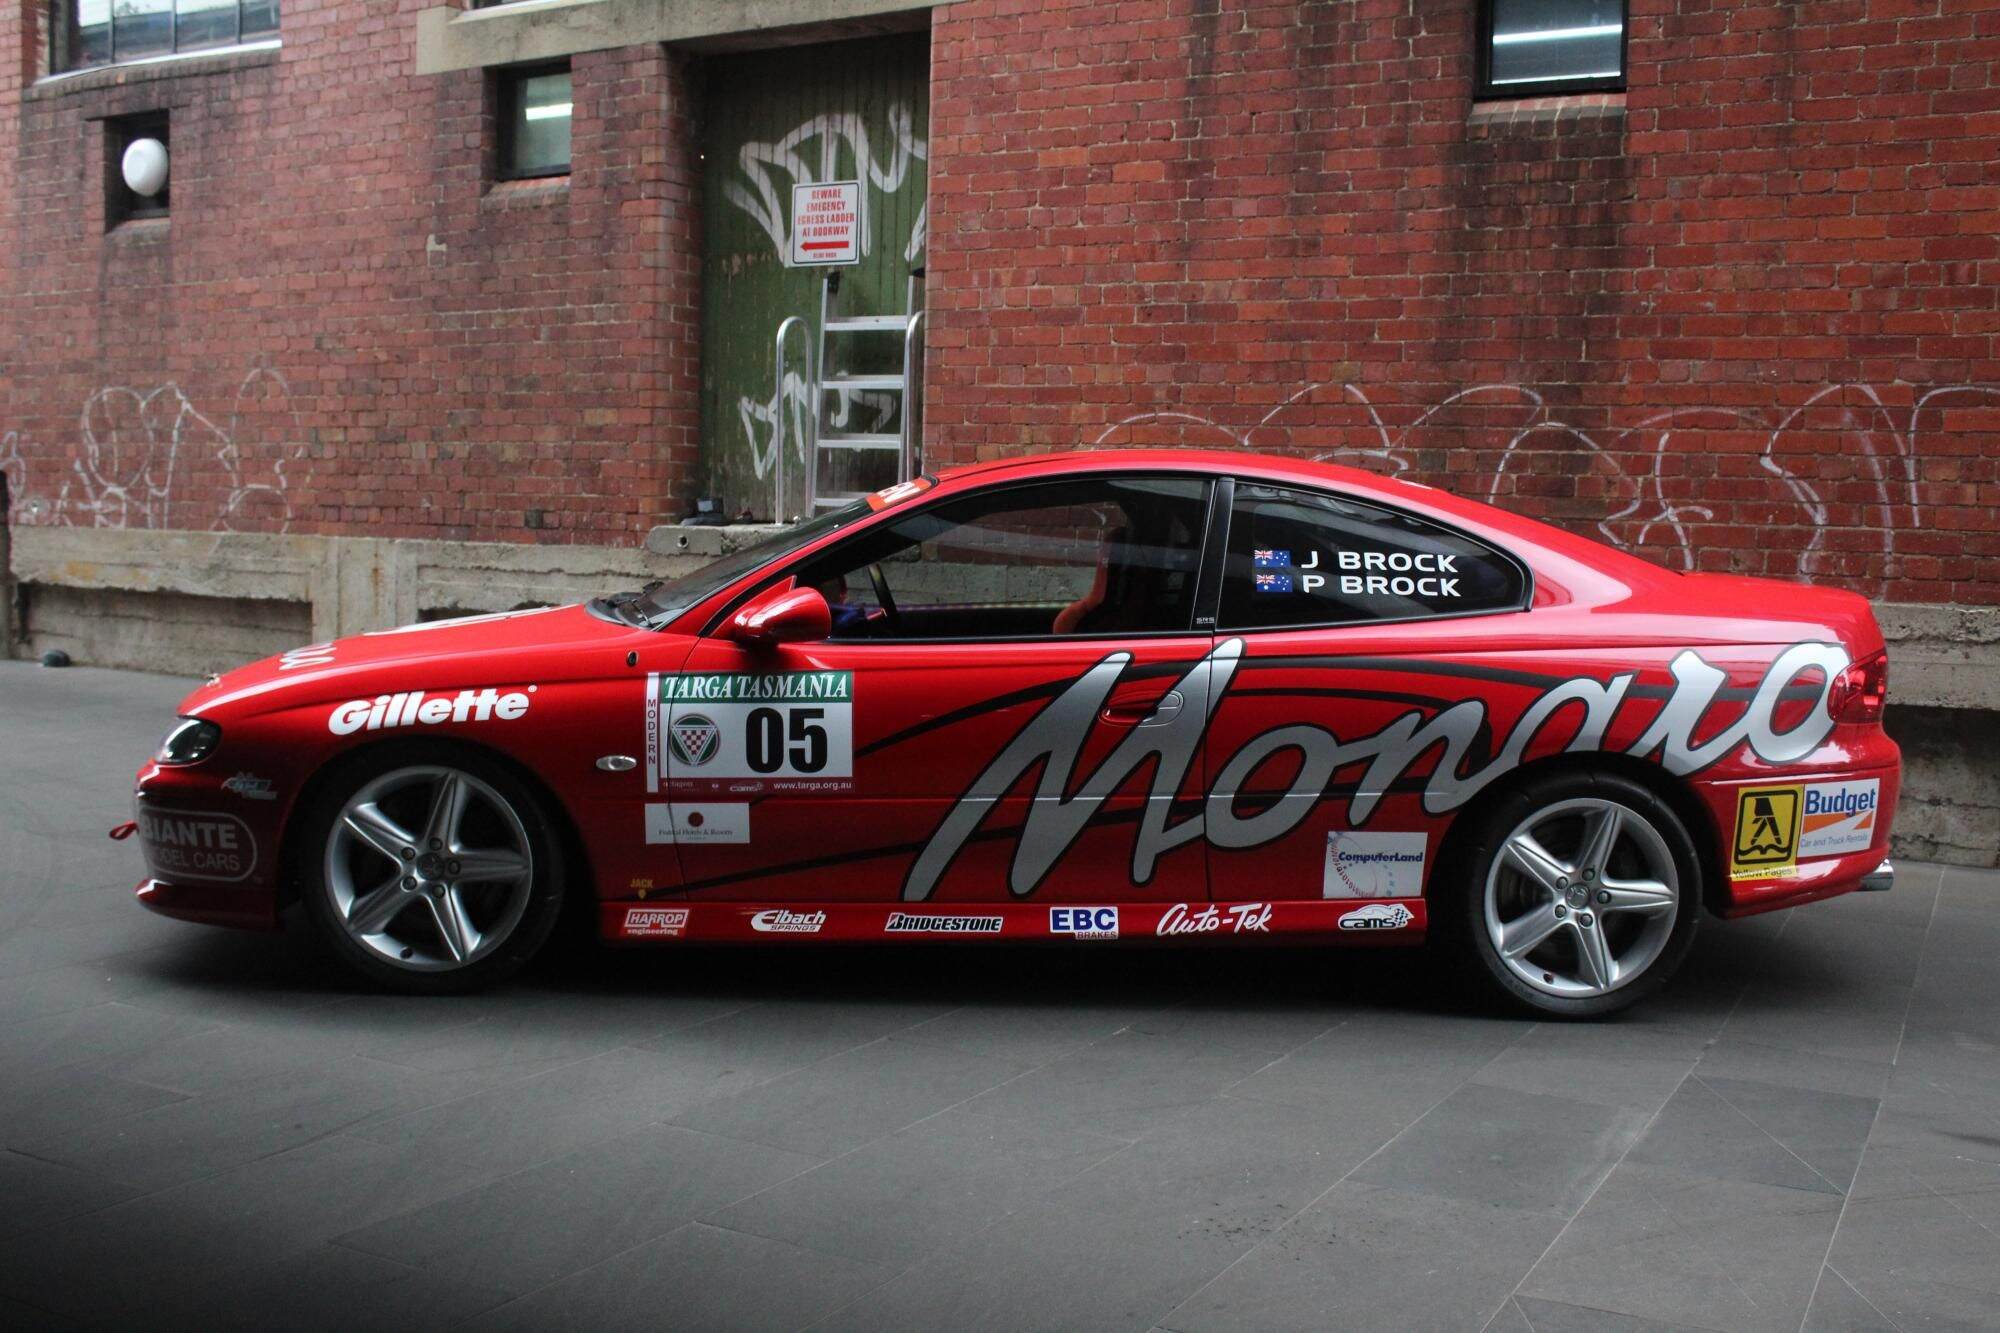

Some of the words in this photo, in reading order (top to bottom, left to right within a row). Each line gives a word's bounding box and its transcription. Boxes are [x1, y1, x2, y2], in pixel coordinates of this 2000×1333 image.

[811, 188, 842, 199] BEWARE
[806, 201, 846, 212] EMEGENCY
[797, 214, 825, 225] EGRESS
[826, 212, 855, 224] LADDER
[802, 227, 811, 238] AT
[813, 226, 849, 237] DOORWAY
[1301, 551, 1319, 569] J
[1338, 551, 1459, 573] BROCK
[1302, 575, 1325, 593] P
[1340, 576, 1461, 597] BROCK
[664, 674, 733, 699] TARGA
[736, 673, 849, 699] TASMANIA
[328, 688, 530, 735] Gillette
[647, 699, 657, 765] MODERN
[745, 707, 828, 774] 05
[902, 637, 1851, 902] Monaro
[773, 781, 852, 791] www.targa.org.au
[1805, 788, 1876, 818] Budget
[140, 812, 239, 849] BIANTE
[193, 852, 241, 871] CARS
[1338, 852, 1423, 863] ComputerLand
[1764, 866, 1793, 878] Pages
[630, 879, 653, 889] JACK
[630, 913, 683, 924] HARROP
[886, 914, 1002, 931] BRIDGESTONE
[1052, 909, 1116, 931] EBC
[1156, 903, 1272, 936] Auto-Tek
[627, 927, 679, 936] engineering
